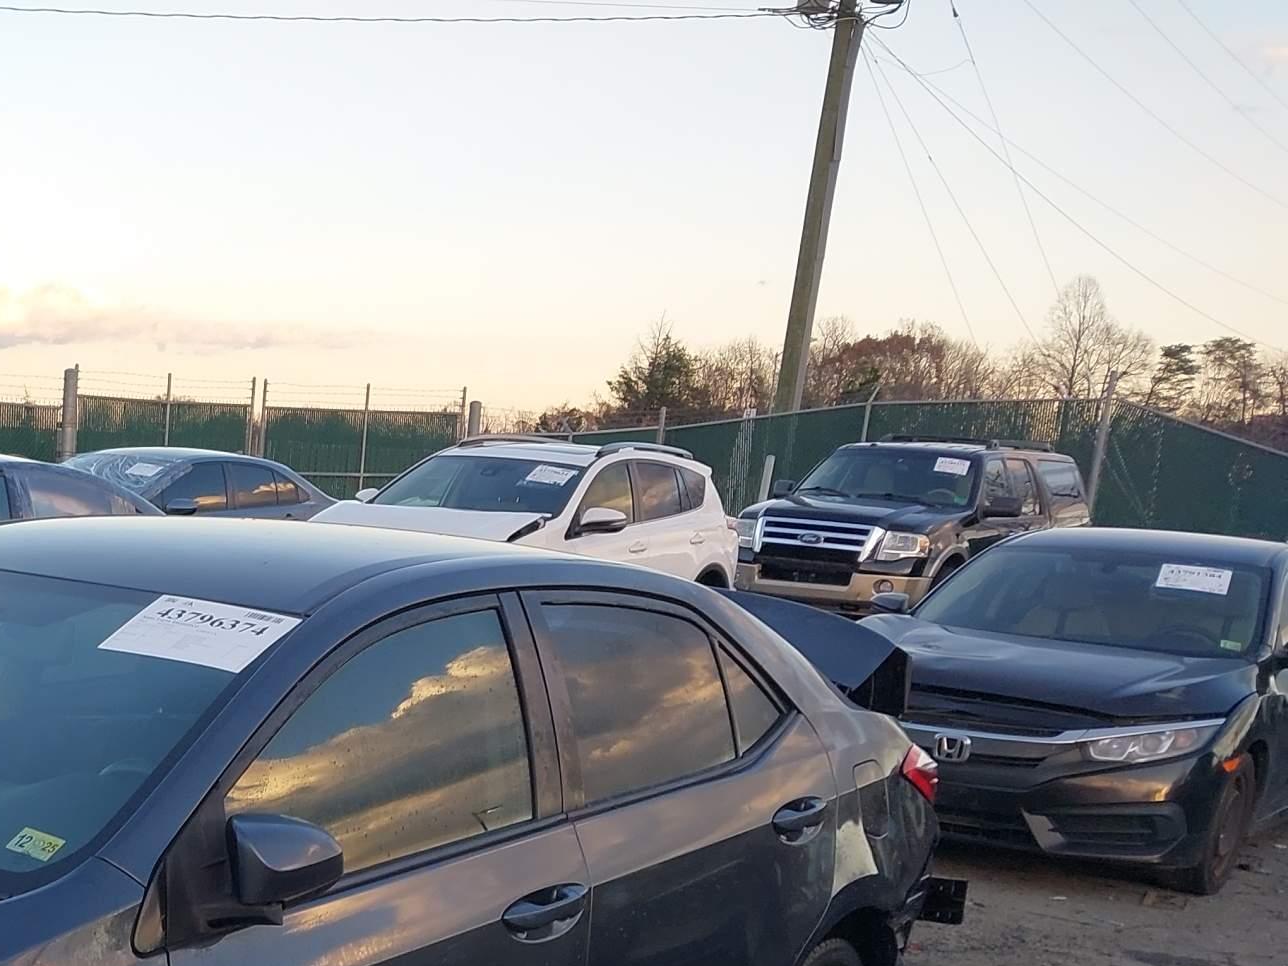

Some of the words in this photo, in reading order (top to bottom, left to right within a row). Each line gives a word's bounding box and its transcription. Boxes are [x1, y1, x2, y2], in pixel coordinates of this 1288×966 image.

[156, 606, 270, 637] 43796374
[14, 833, 34, 848] 12
[41, 841, 60, 853] 25
